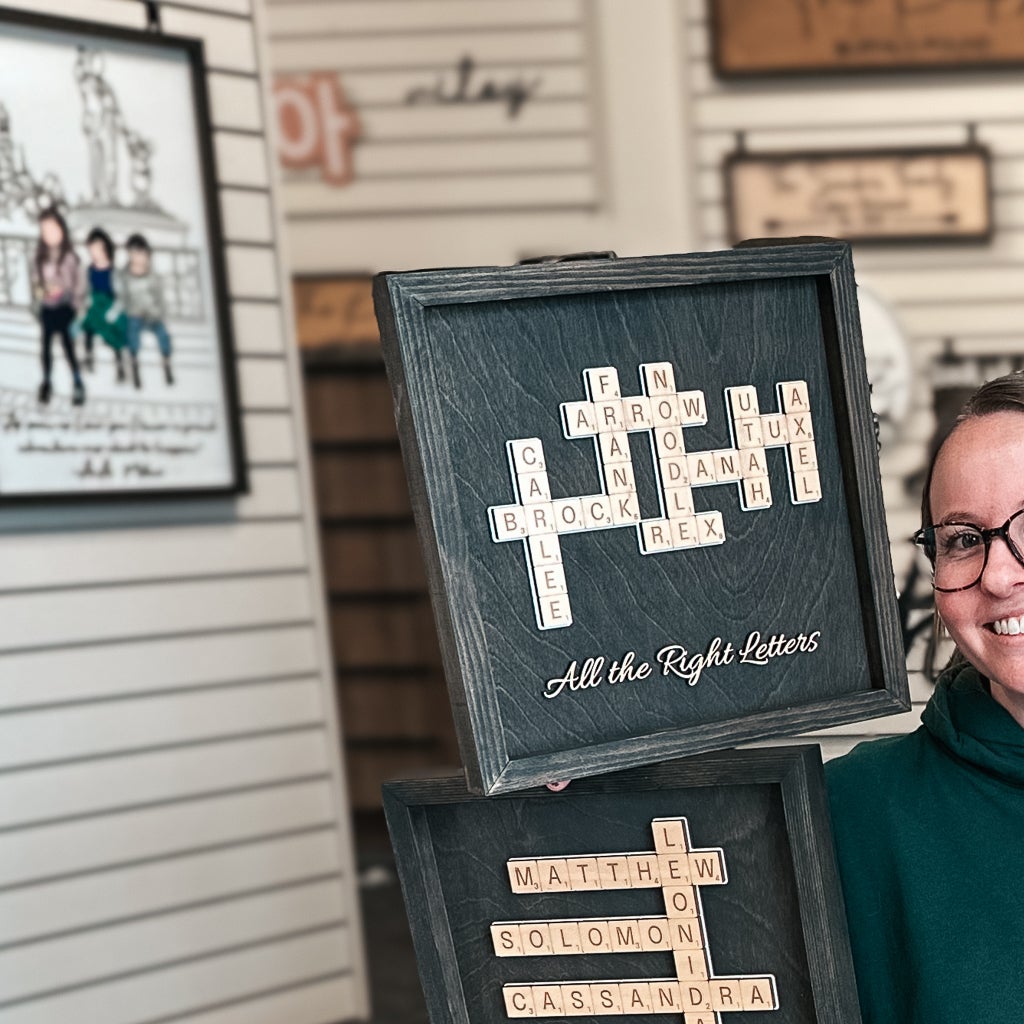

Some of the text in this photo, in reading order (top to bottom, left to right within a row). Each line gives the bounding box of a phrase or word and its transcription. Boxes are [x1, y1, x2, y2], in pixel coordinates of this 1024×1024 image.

[575, 397, 706, 431] ARROW
[741, 416, 813, 444] TUX
[599, 374, 640, 520] FRANK
[653, 369, 697, 542] NOODLE
[738, 392, 770, 504] UTAH
[790, 387, 819, 495] AXEL
[668, 452, 766, 485] DANA
[504, 498, 639, 534] BROCK
[521, 446, 569, 621] CARLEE
[651, 518, 724, 546] REX
[543, 631, 821, 698] All the Right Letters
[515, 856, 721, 890] MATTHEW
[500, 923, 700, 953] SOLOMON
[511, 984, 772, 1015] CASSANDRA
